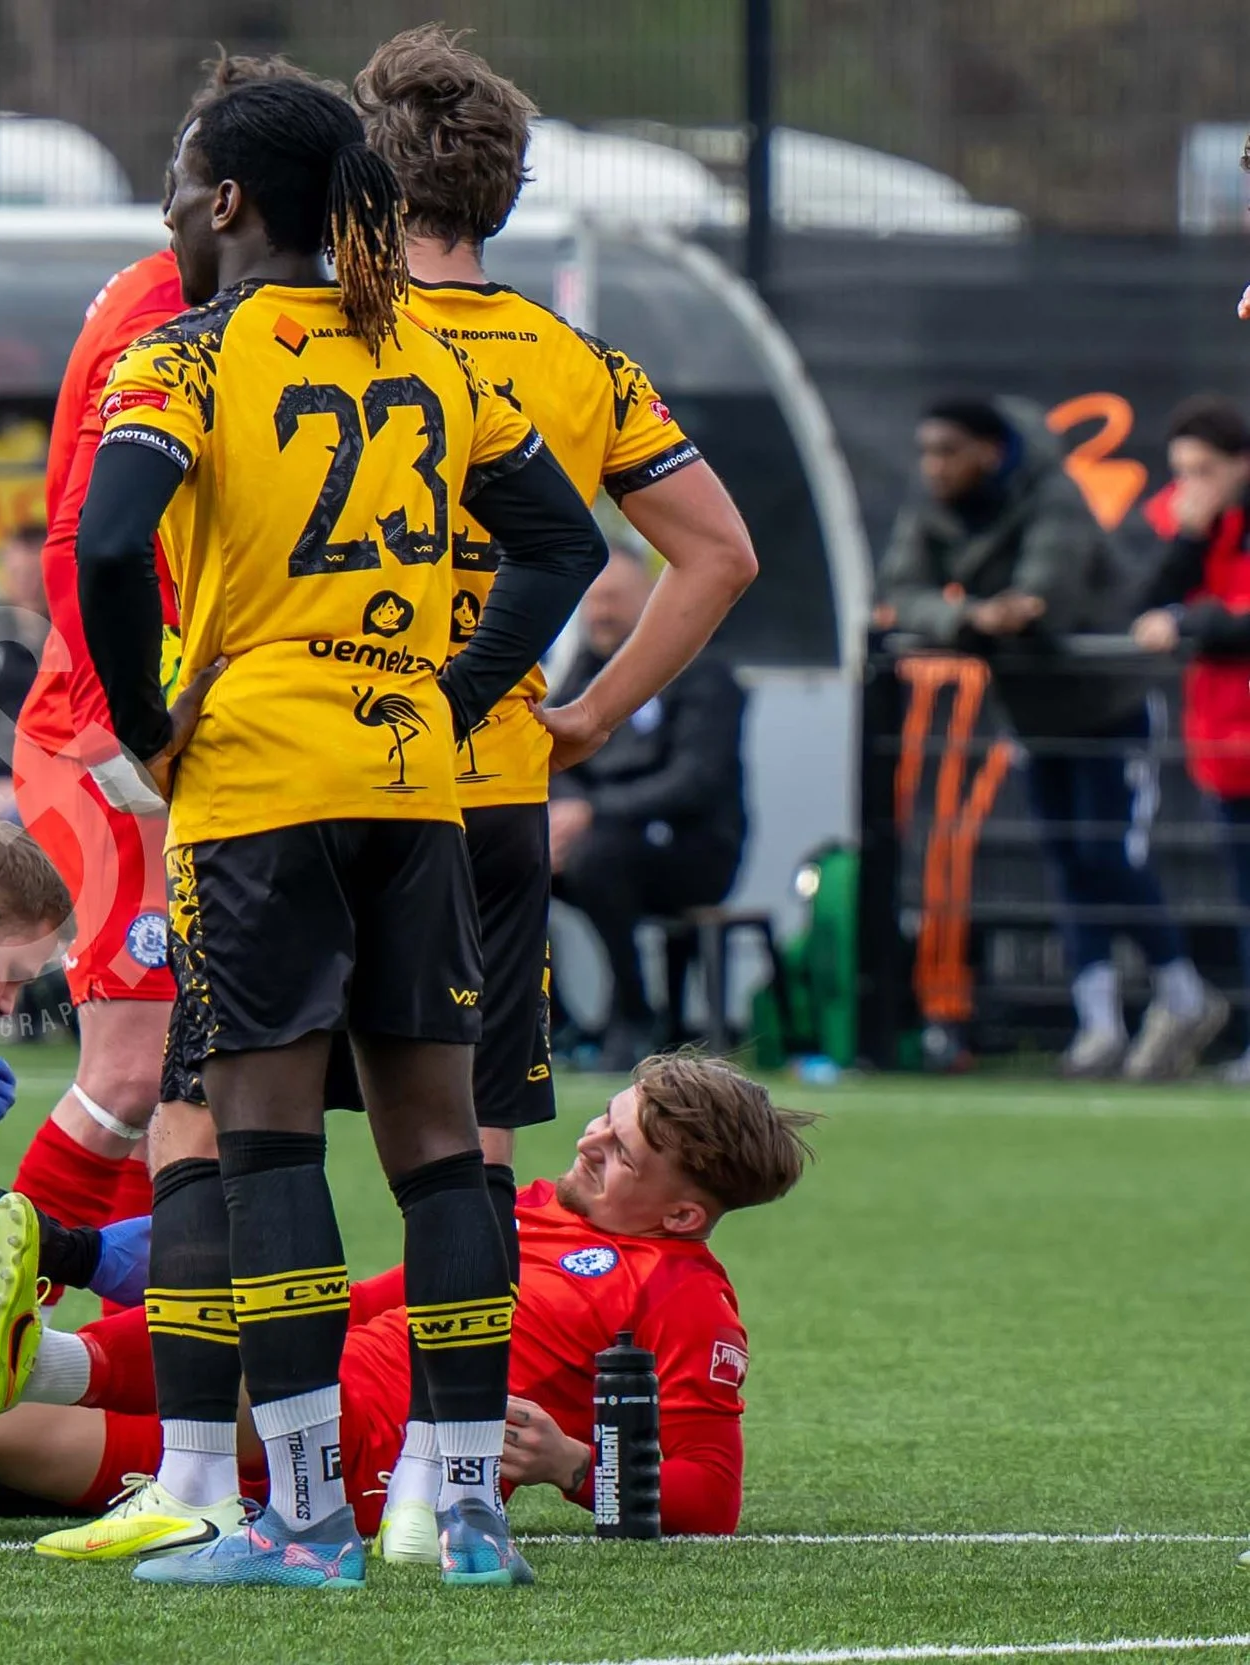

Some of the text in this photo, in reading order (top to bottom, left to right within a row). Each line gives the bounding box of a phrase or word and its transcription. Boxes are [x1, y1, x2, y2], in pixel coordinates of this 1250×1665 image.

[311, 328, 333, 338] L&G
[461, 329, 517, 340] ROOFING
[518, 331, 538, 342] LTD
[110, 430, 169, 450] FOOTBALL
[649, 448, 694, 478] LONDONS
[273, 372, 449, 579] 23
[284, 1280, 350, 1301] CW
[602, 1424, 620, 1525] SUPPLEMENT
